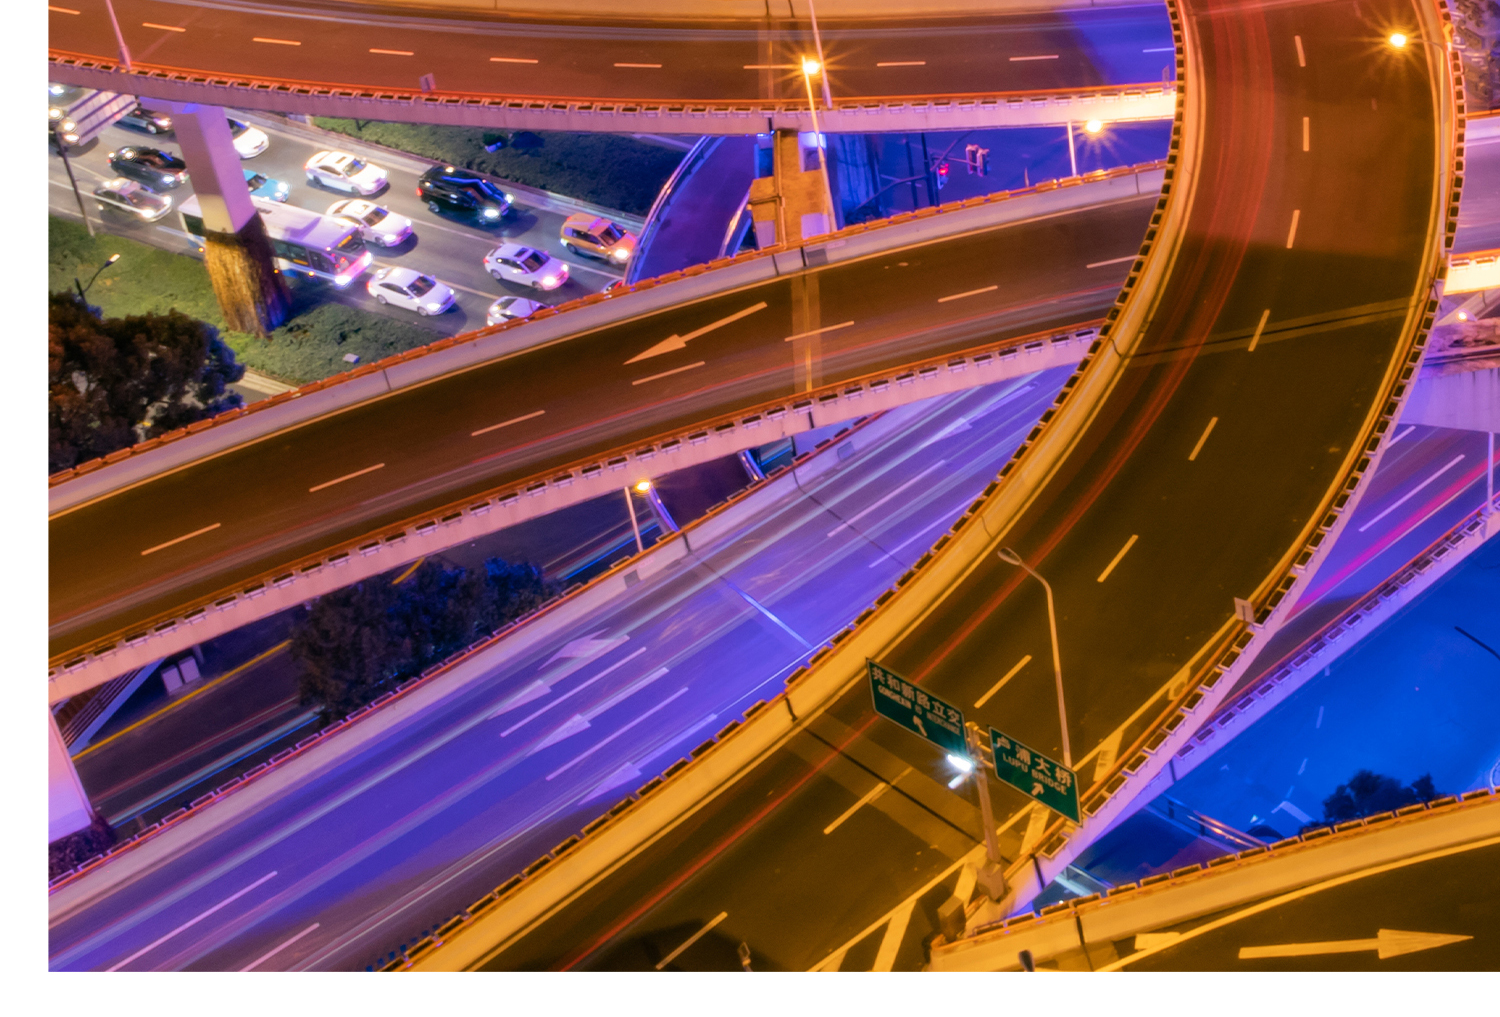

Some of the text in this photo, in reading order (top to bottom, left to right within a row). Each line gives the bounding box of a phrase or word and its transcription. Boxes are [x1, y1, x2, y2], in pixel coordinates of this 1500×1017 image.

[872, 666, 961, 727] 共和新路立交
[996, 736, 1072, 788] 卢浦大桥
[1002, 752, 1067, 796] LUPU BRIDGE
